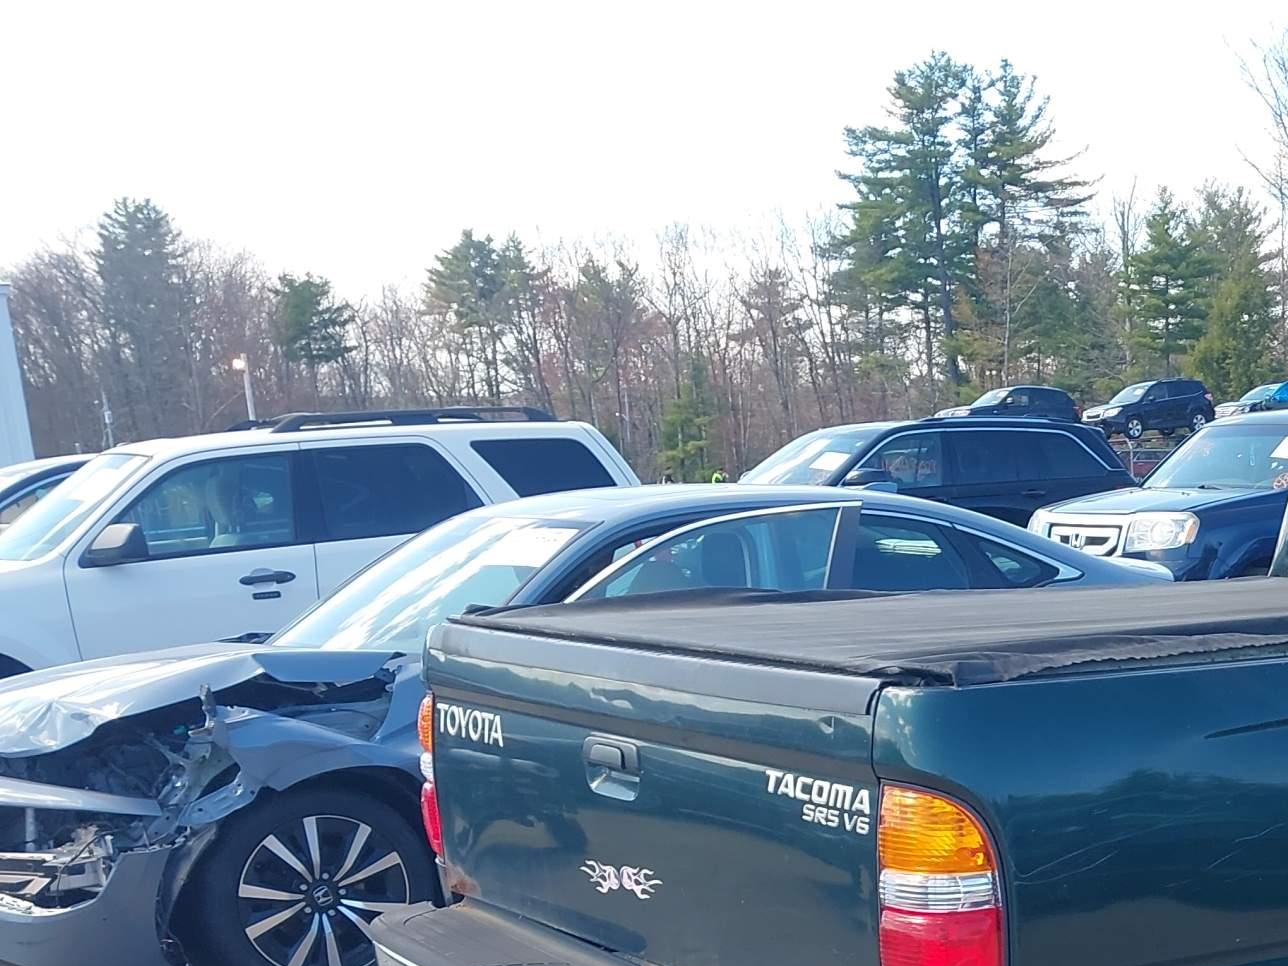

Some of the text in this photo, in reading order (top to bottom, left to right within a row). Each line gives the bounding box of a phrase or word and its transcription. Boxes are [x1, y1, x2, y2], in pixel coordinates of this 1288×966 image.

[436, 702, 504, 748] TOYOTA
[765, 769, 871, 814] TACOMA
[801, 803, 870, 835] SR5 V6
